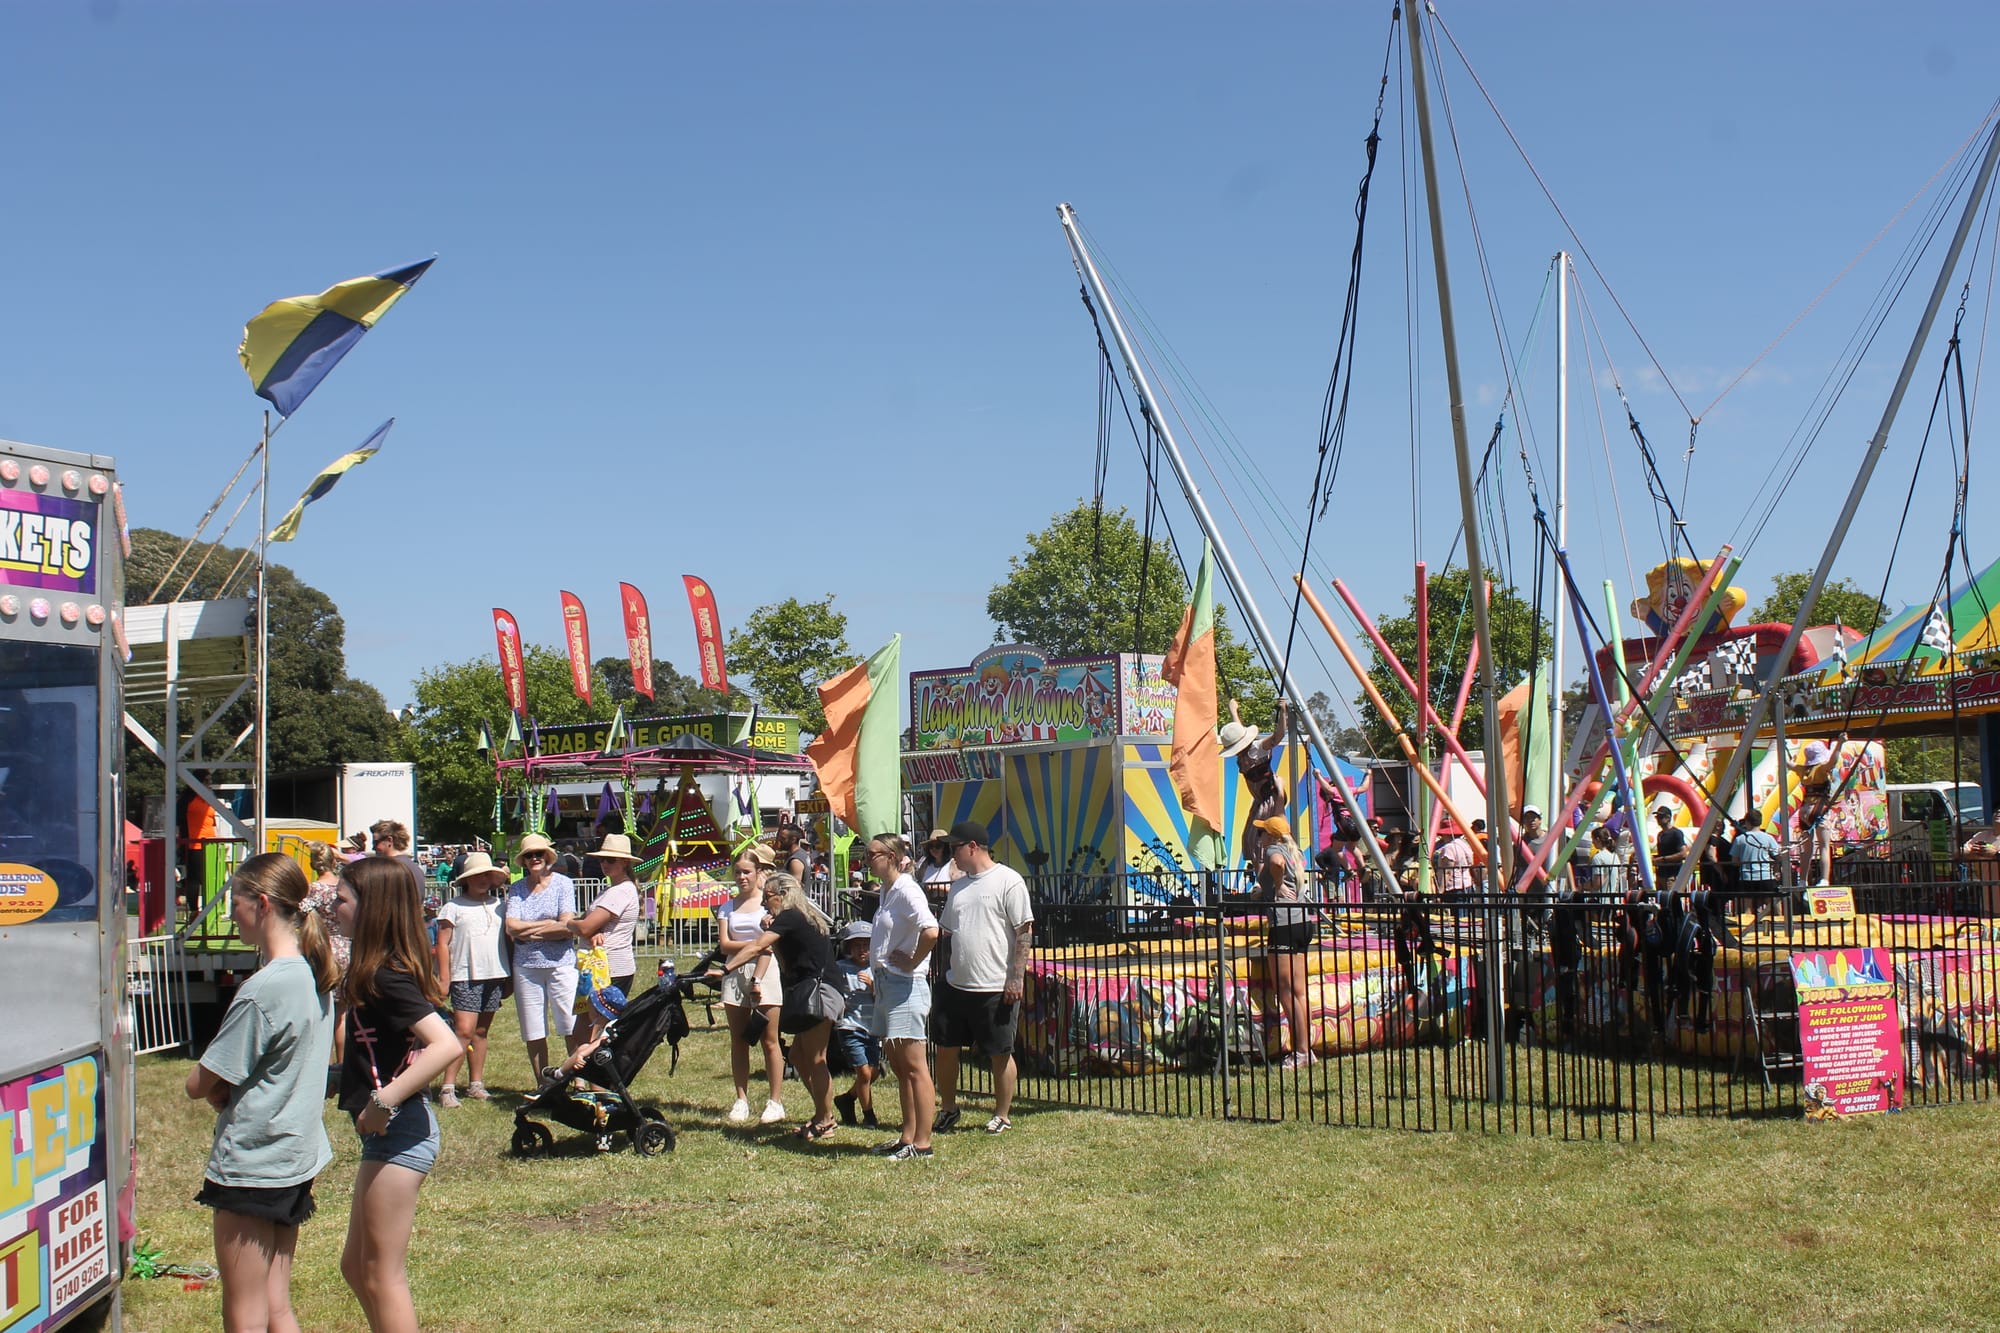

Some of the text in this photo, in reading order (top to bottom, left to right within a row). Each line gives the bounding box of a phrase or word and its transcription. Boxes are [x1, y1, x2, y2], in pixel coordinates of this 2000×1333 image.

[698, 607, 720, 685] HOT CHIPS
[1852, 682, 1937, 707] DODGEM
[919, 677, 1085, 741] Laughing Clowns
[755, 721, 785, 733] RAB
[539, 733, 587, 754] GRAB
[363, 769, 405, 777] FREIGHTER
[799, 801, 826, 813] EXIT
[1814, 900, 1827, 914] 8
[1802, 985, 1891, 1003] SUPER JUMP
[1809, 1004, 1884, 1017] THE FOLLOWING
[1809, 1013, 1887, 1026] MUST NOT JUMP
[1833, 1059, 1856, 1067] CANNOT
[1848, 1079, 1872, 1087] LOOSE
[1835, 1085, 1869, 1096] OBJECTS
[1852, 1094, 1881, 1103] SHARPS
[1844, 1103, 1877, 1113] OBJECTS
[58, 1190, 98, 1235] FOR
[54, 1219, 104, 1272] HIRE
[56, 1258, 105, 1306] 9740 9262
